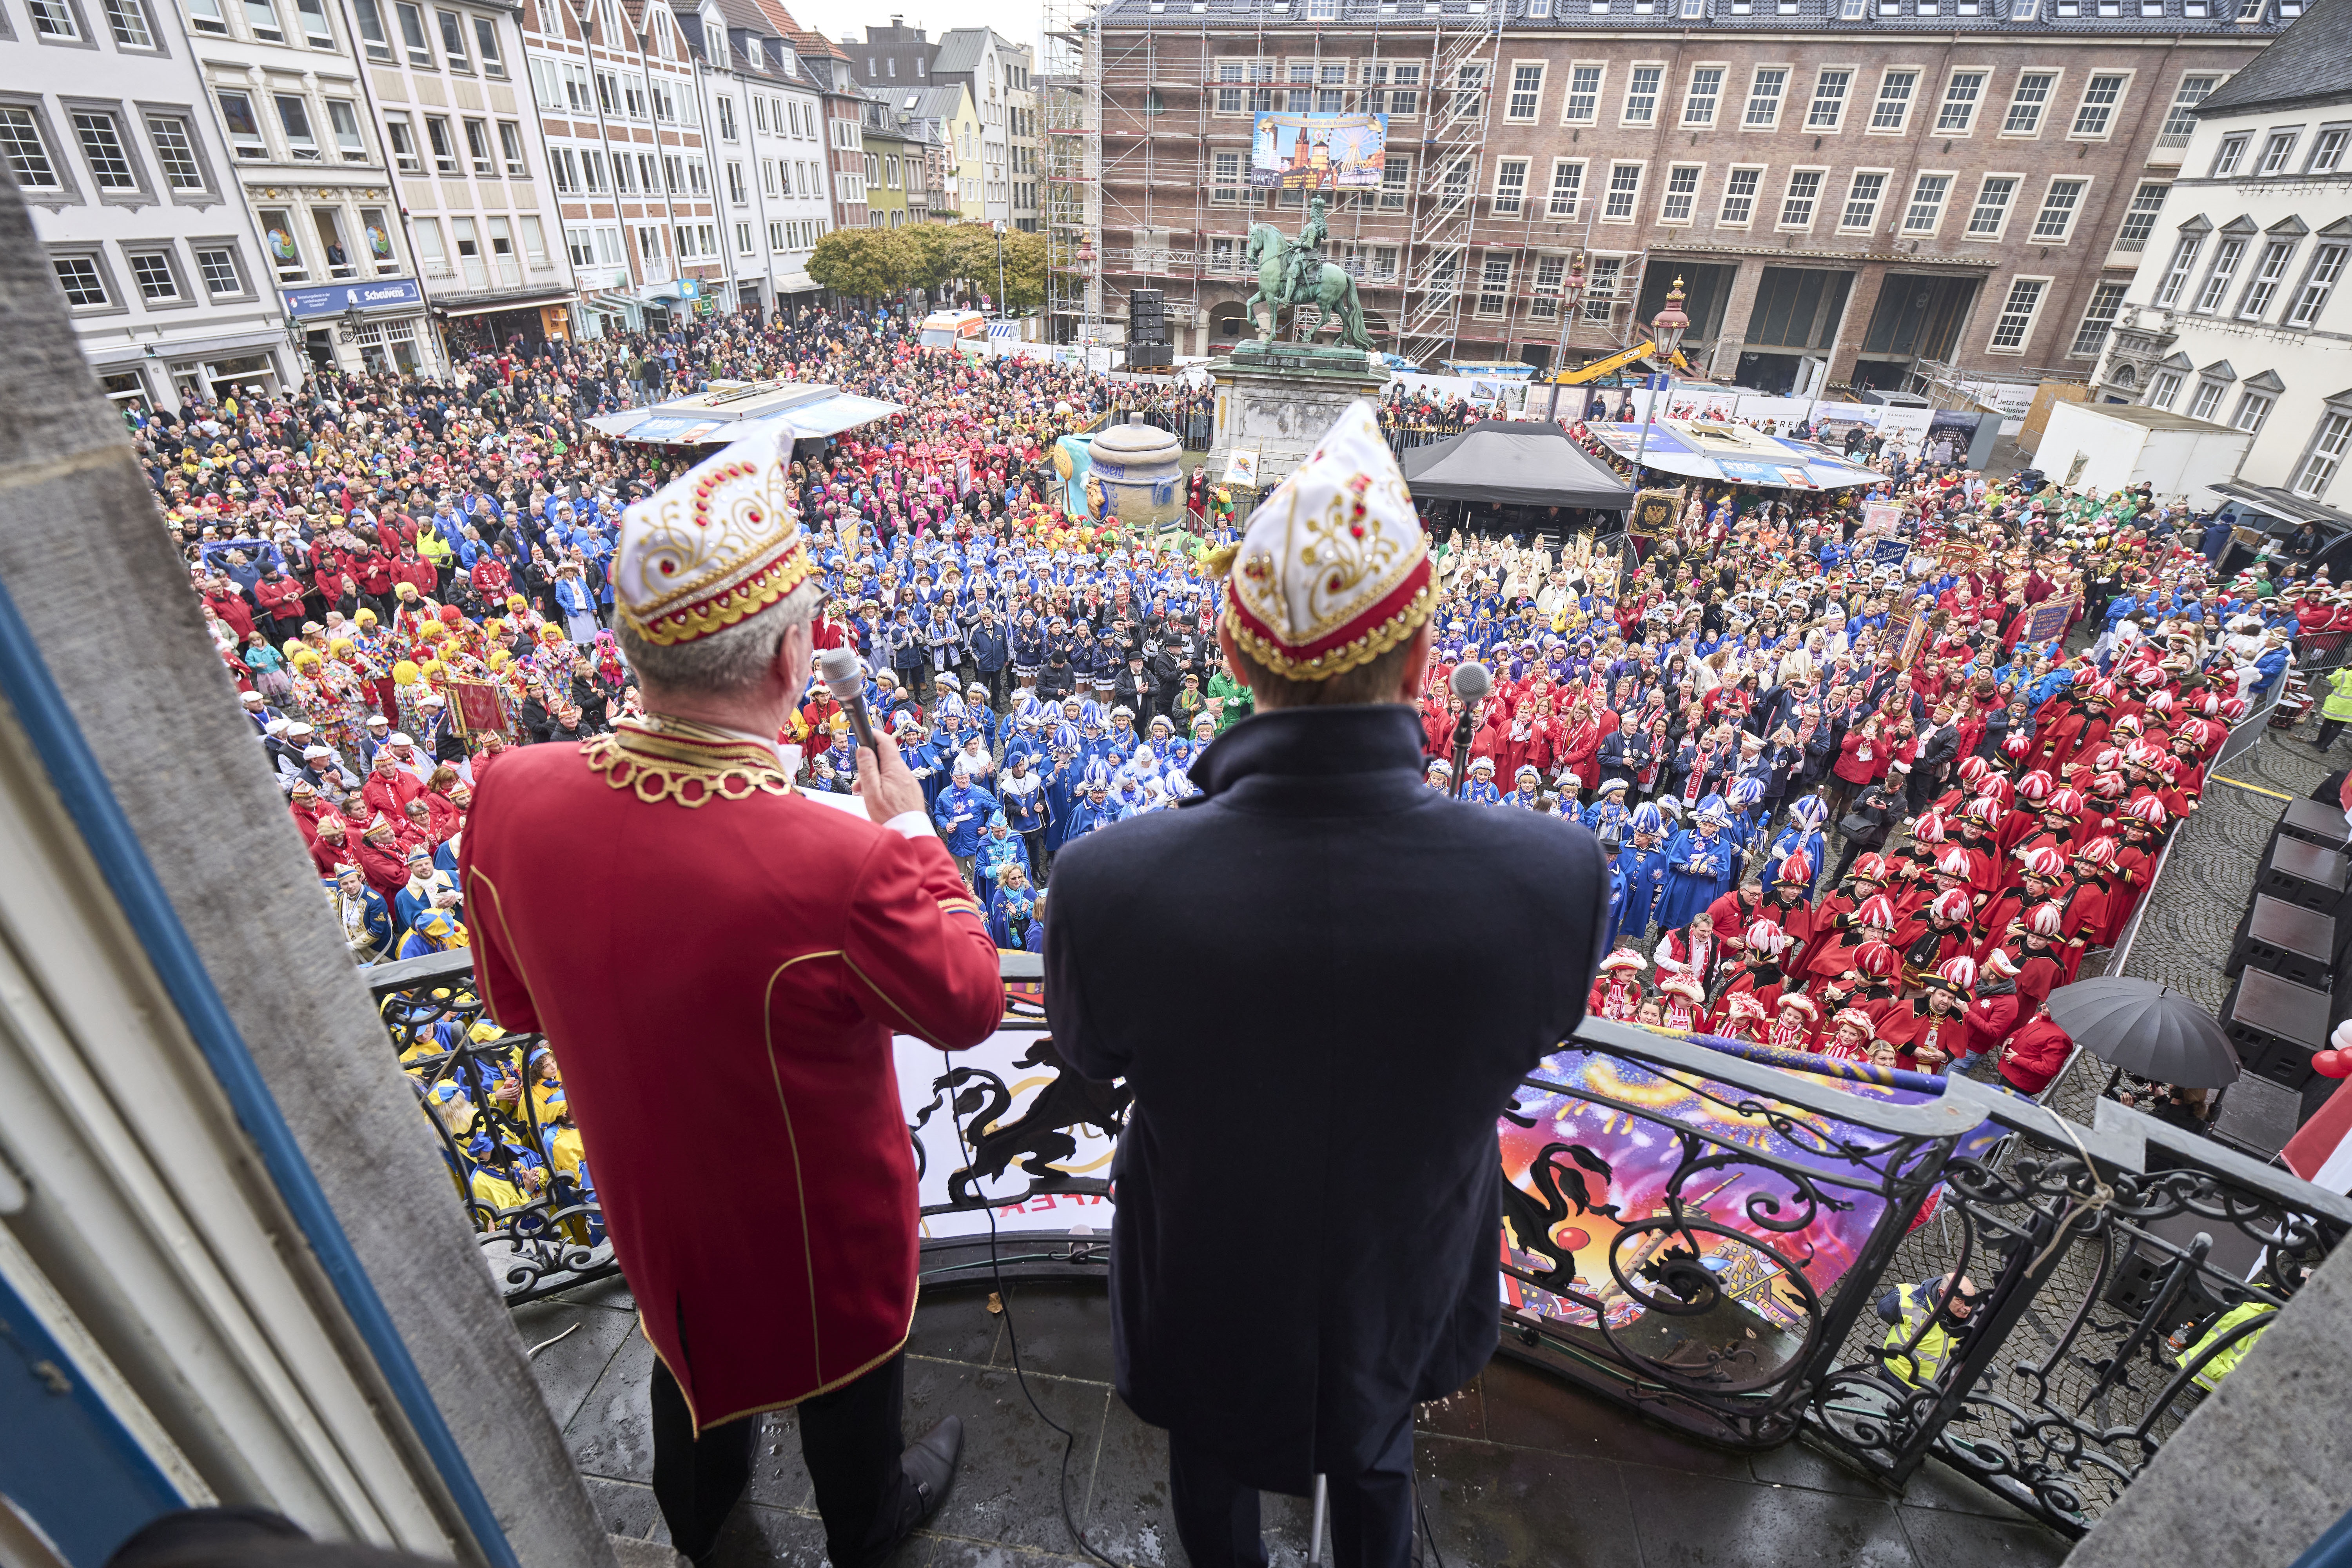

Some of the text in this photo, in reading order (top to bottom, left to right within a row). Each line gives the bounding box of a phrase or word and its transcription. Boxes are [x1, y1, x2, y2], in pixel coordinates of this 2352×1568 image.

[365, 289, 405, 301] Scheuvens
[1622, 348, 1641, 361] JCB
[480, 570, 494, 587] 1961
